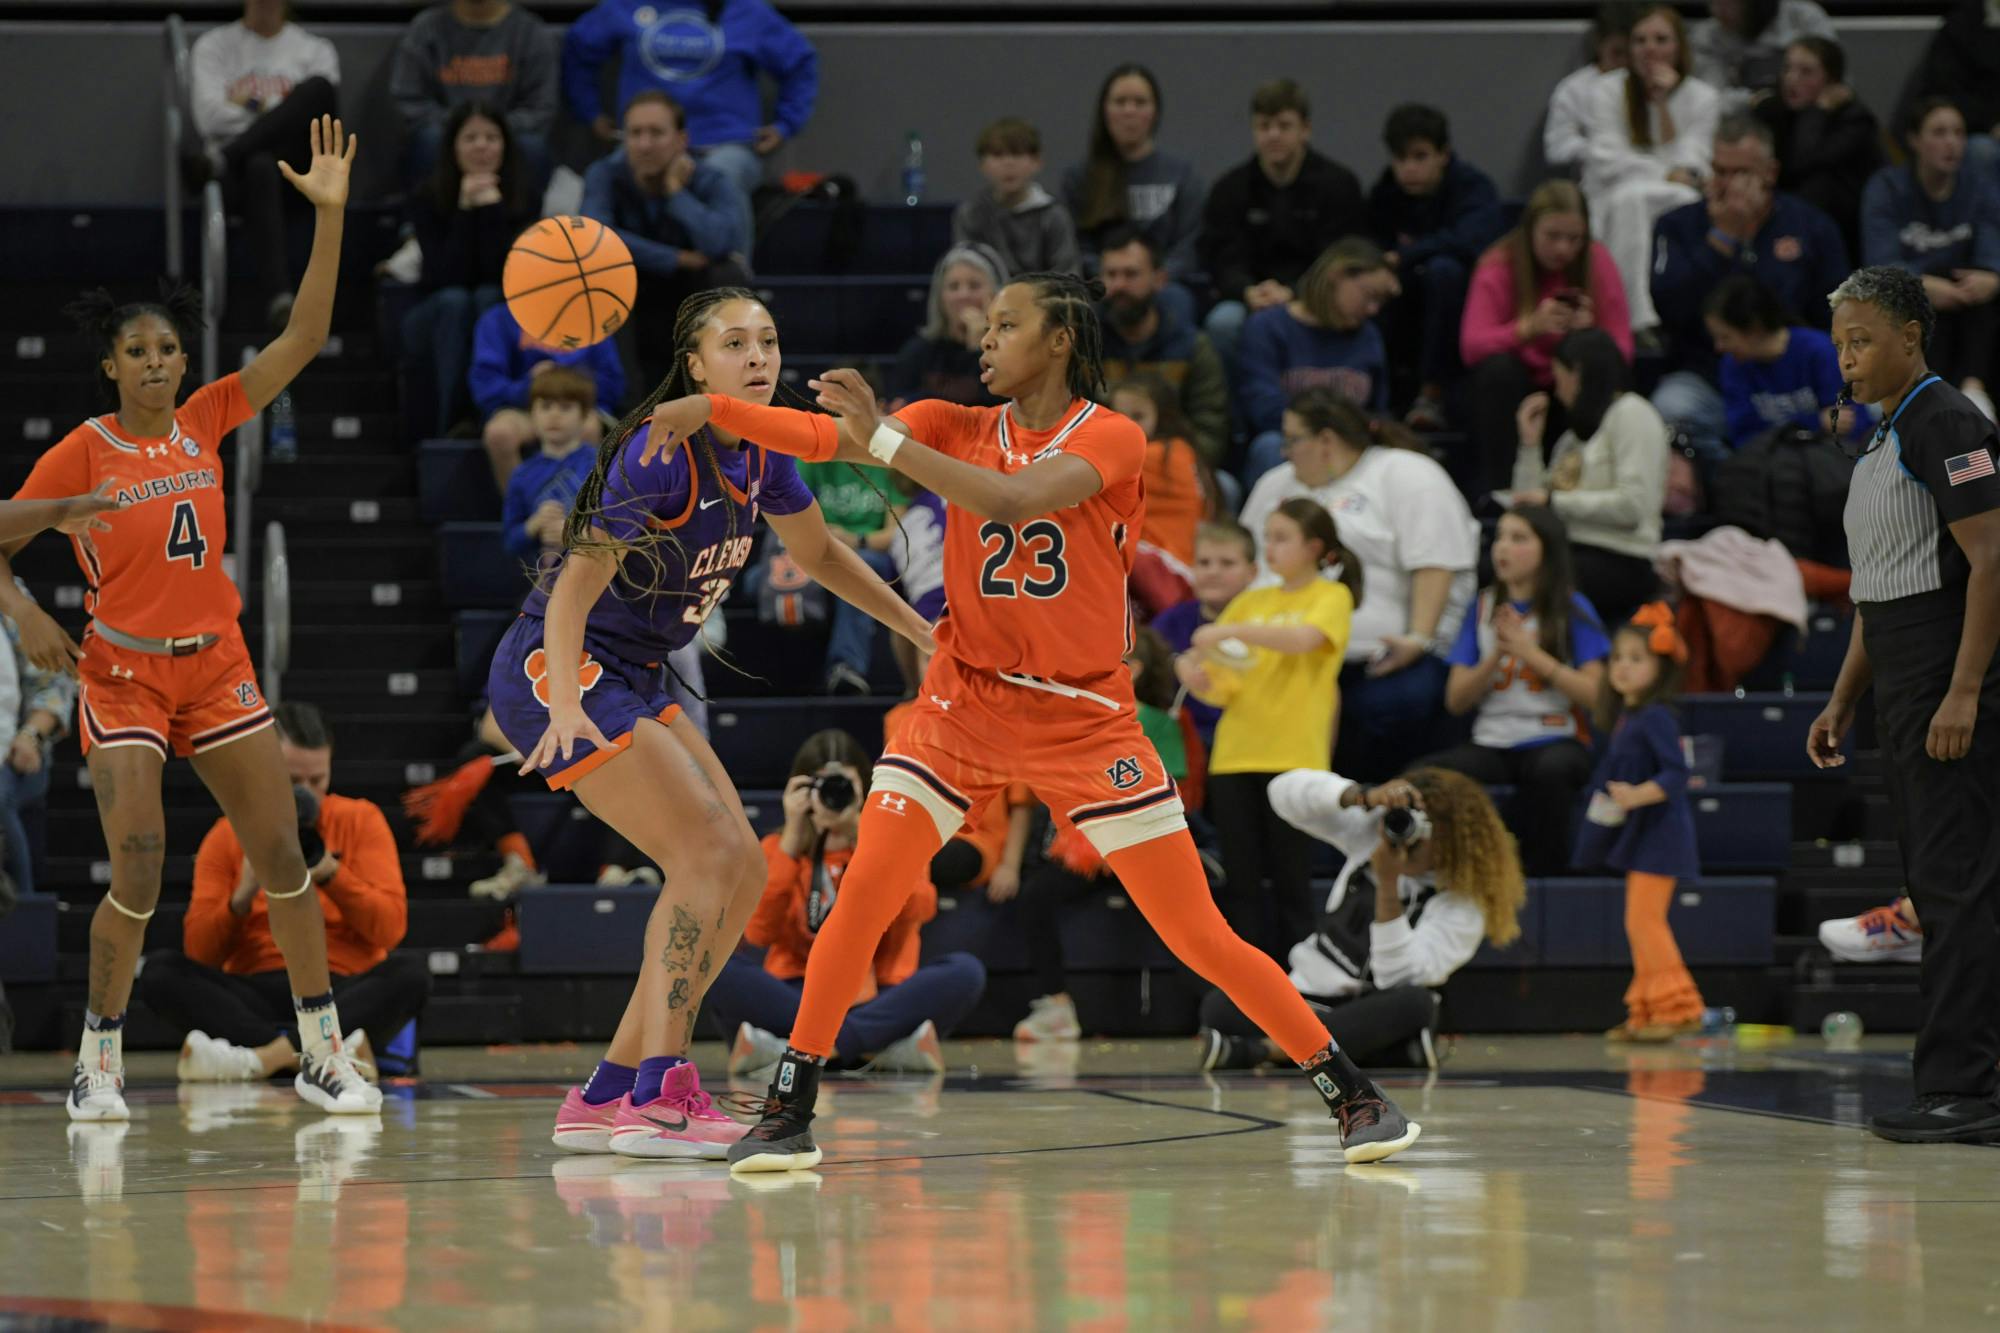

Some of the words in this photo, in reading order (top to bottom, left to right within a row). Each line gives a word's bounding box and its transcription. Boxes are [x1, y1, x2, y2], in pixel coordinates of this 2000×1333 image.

[116, 469, 217, 507] AUBURN
[165, 499, 208, 570] 4
[978, 518, 1069, 600] 23
